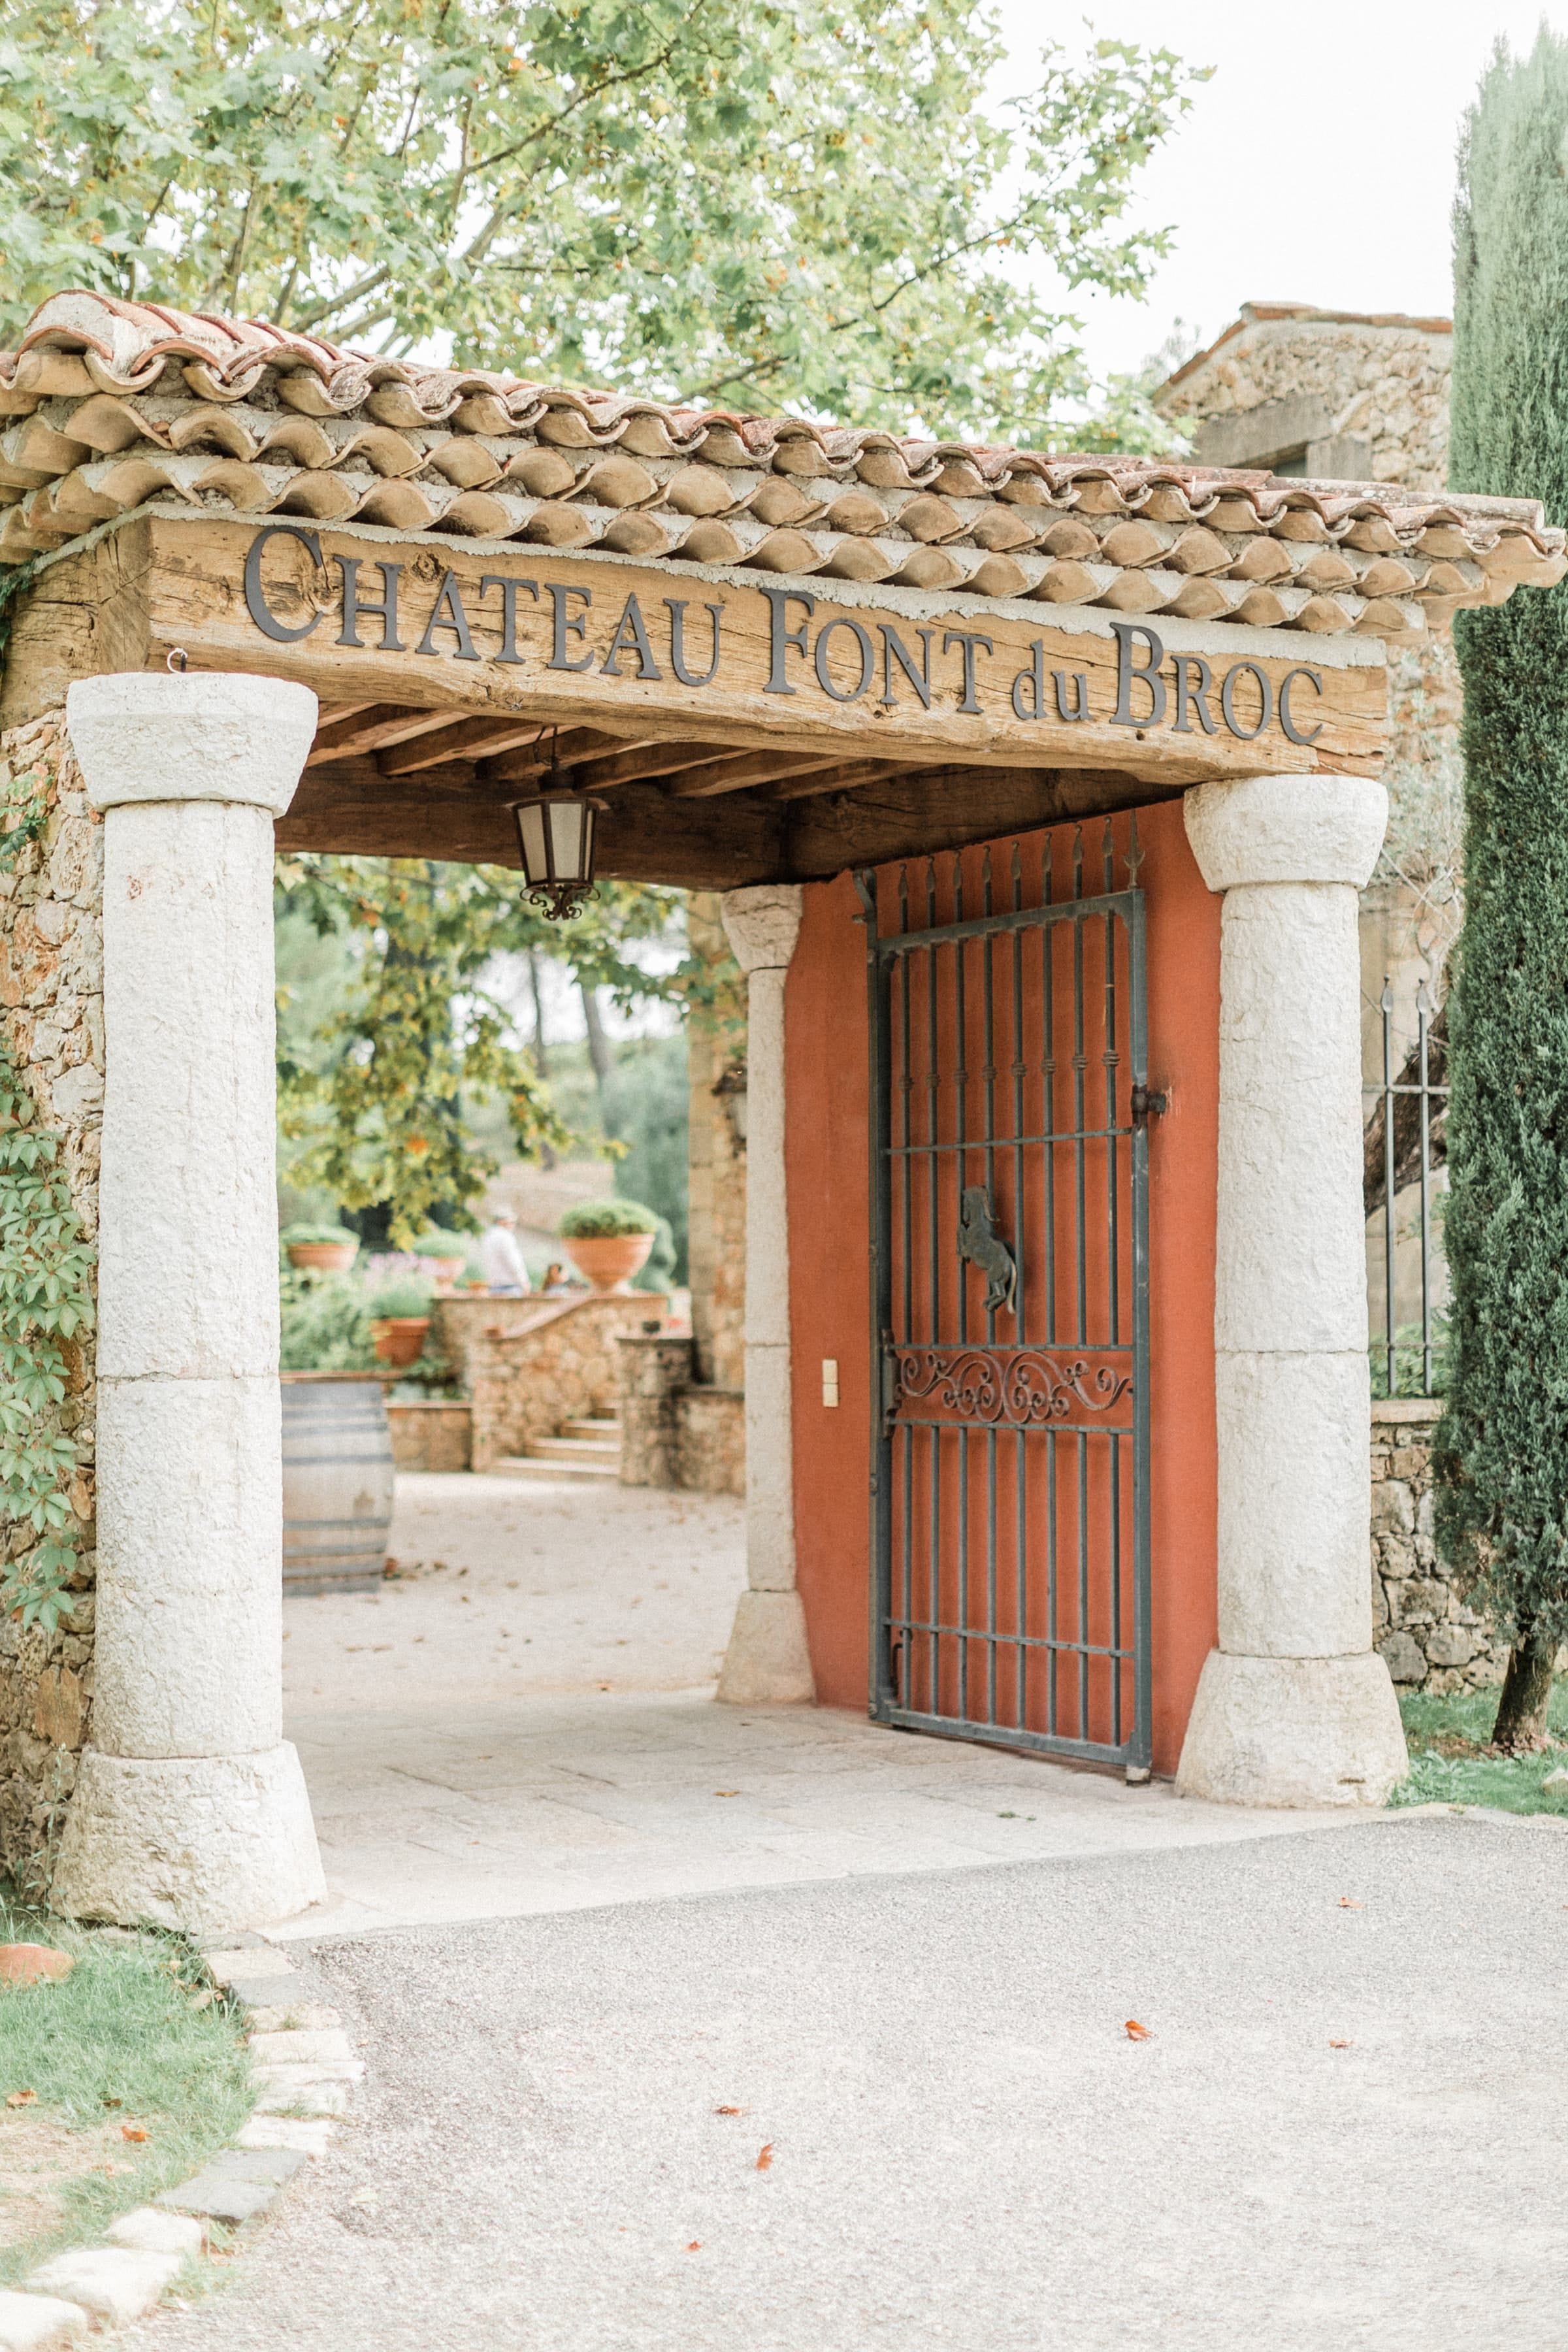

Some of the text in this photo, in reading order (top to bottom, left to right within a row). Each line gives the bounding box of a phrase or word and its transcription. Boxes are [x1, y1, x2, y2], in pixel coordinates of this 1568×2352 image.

[244, 525, 1324, 745] CHATEAU FONT du BROC
